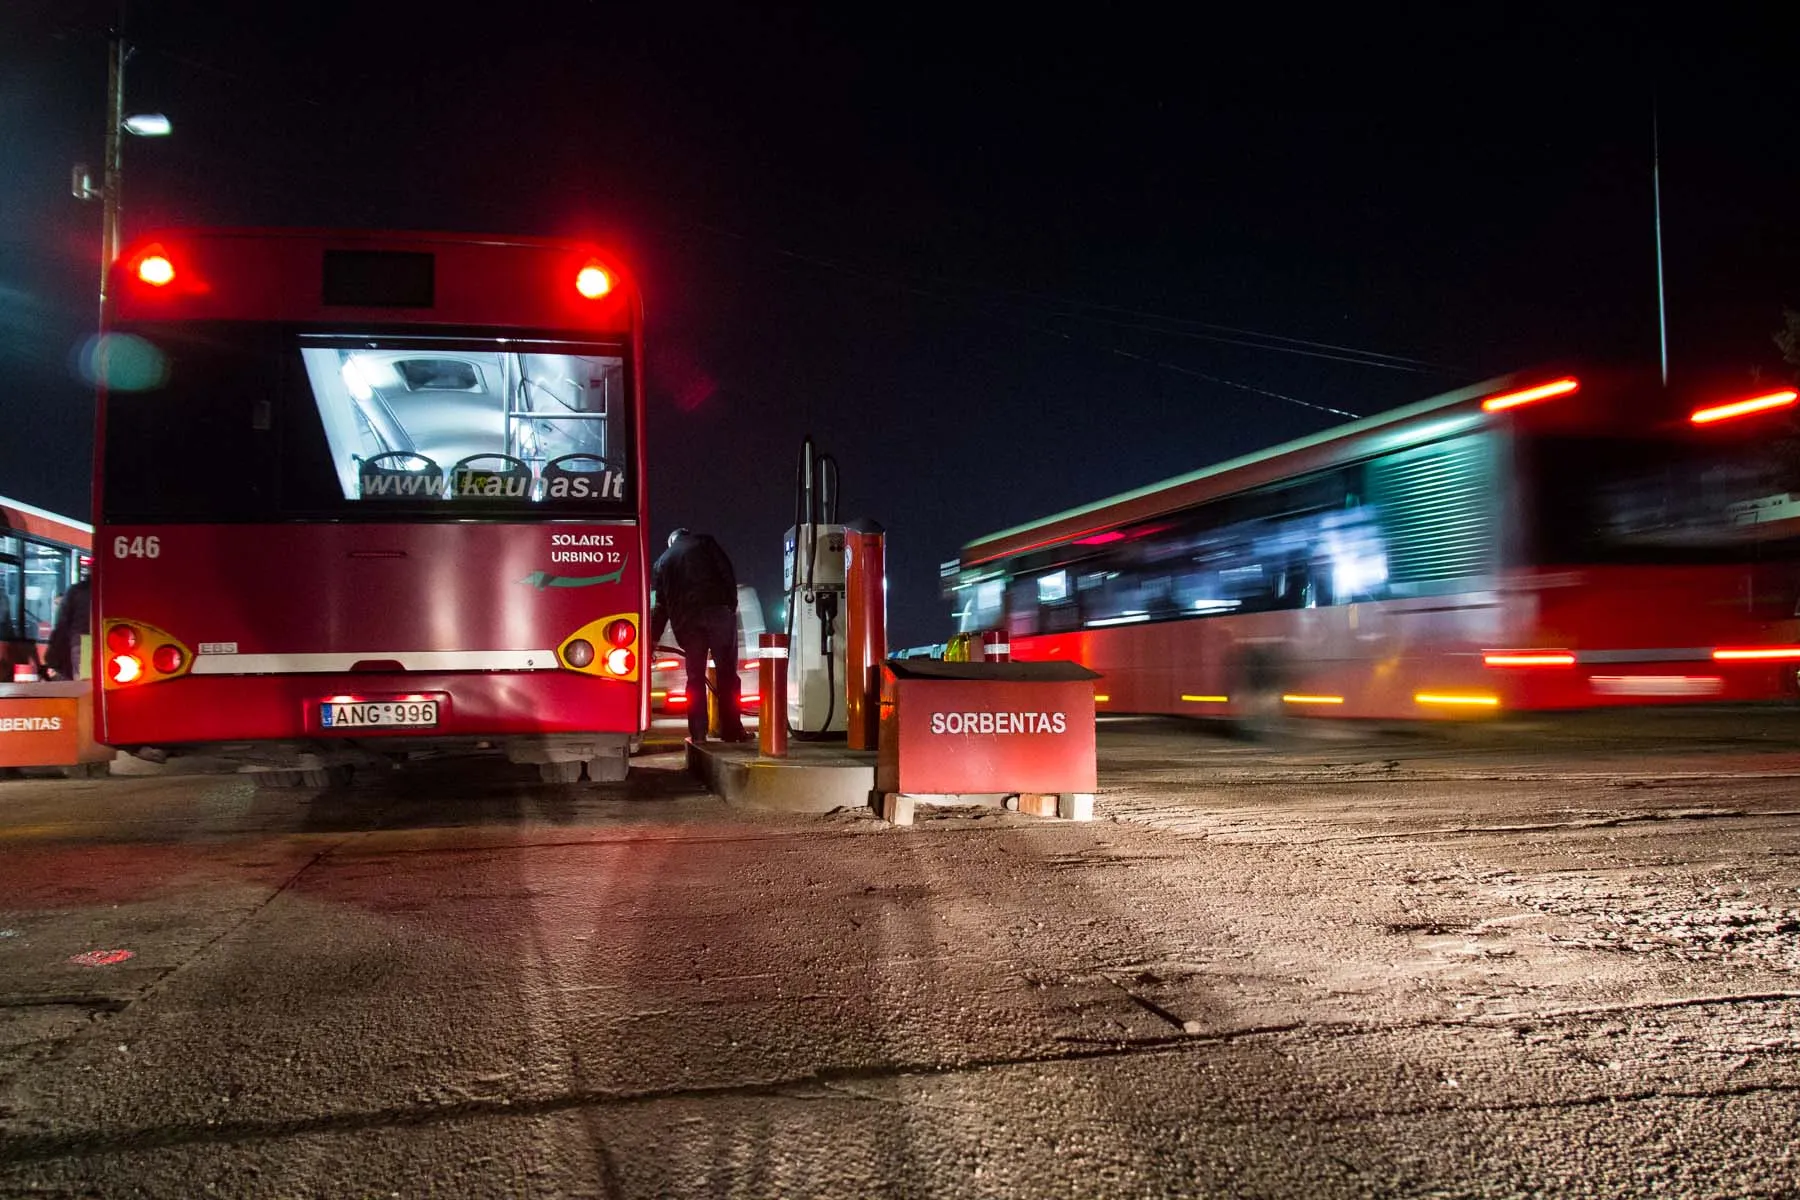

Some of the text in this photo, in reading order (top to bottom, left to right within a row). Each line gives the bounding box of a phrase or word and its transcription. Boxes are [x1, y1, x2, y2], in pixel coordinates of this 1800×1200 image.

[362, 470, 625, 498] www.kaunas.lt
[113, 535, 160, 559] 646
[551, 534, 614, 546] SOLARIS
[551, 551, 620, 563] URBINO 12
[0, 717, 61, 731] BENTAS
[336, 705, 380, 725] ANG
[394, 704, 433, 723] 996
[931, 712, 1066, 734] SORBENTAS
